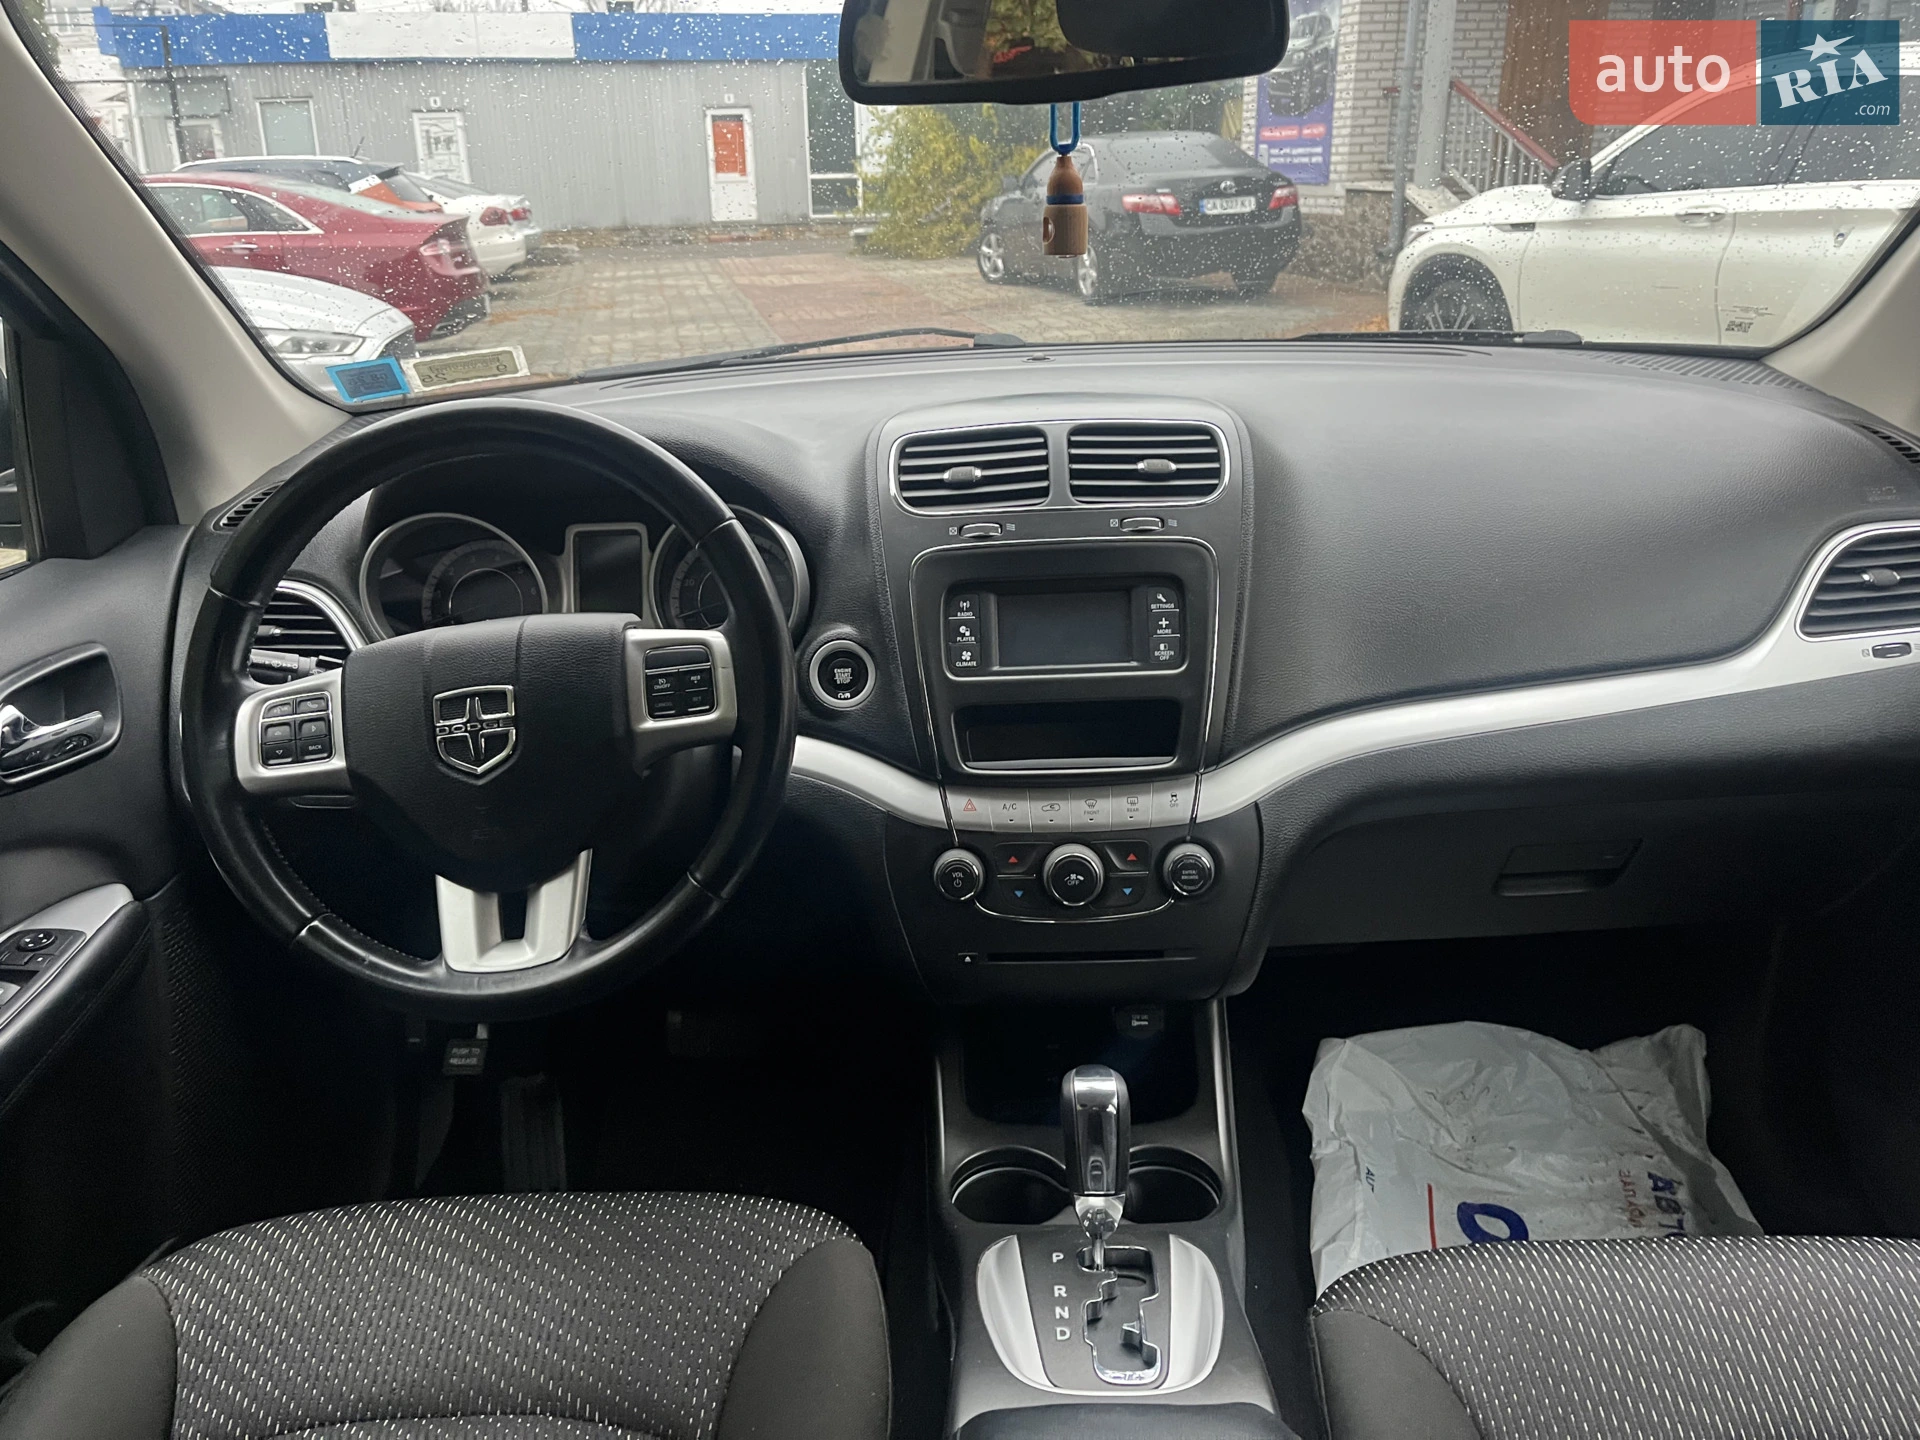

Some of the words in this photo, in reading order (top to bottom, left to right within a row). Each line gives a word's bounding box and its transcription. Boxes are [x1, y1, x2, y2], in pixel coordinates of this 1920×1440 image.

[1150, 602, 1175, 610] SETTINGS
[435, 718, 514, 736] DODGE
[1002, 803, 1017, 811] A/C
[1051, 1251, 1064, 1263] P
[1053, 1285, 1067, 1297] R
[1055, 1306, 1069, 1319] N
[1055, 1327, 1070, 1341] D
